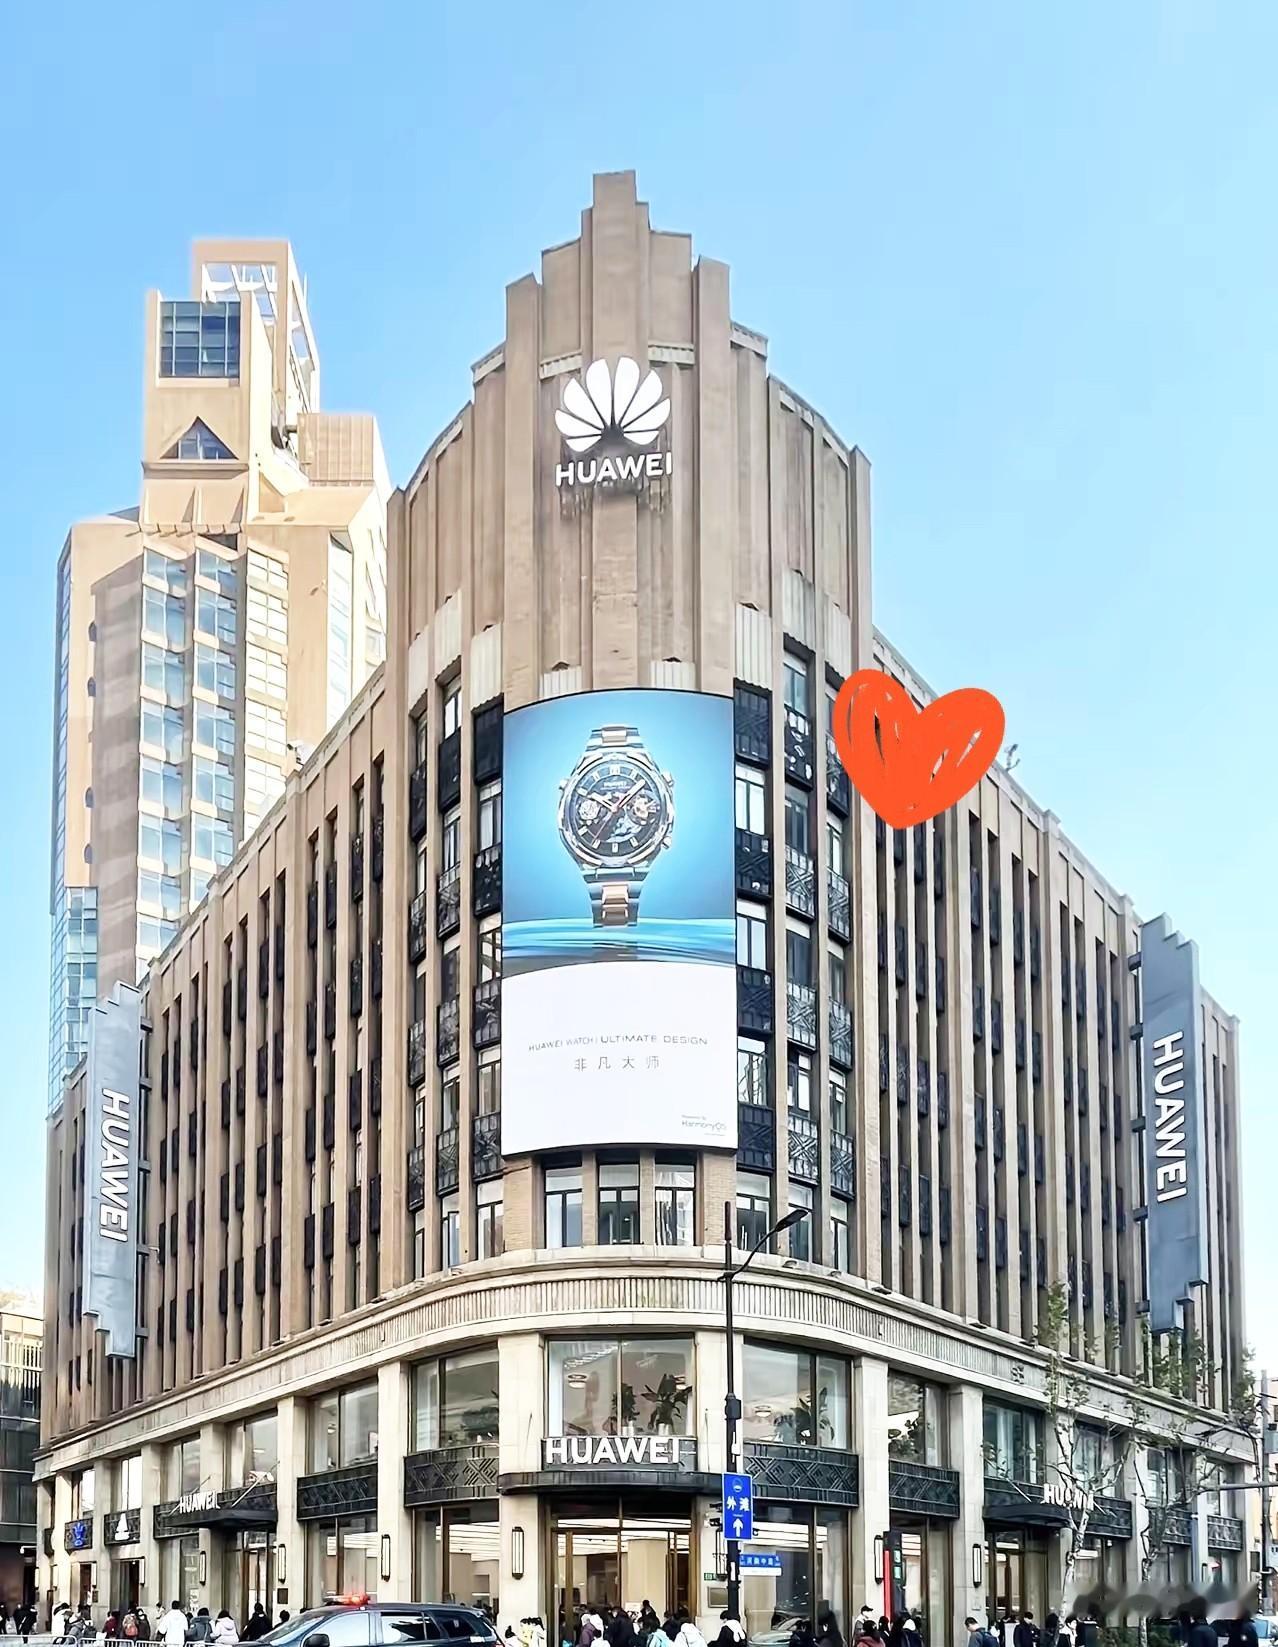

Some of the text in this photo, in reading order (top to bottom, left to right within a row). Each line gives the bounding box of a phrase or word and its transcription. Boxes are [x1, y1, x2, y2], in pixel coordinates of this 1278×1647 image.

[555, 452, 672, 486] HUAWEI
[528, 1035, 708, 1051] HUAWEI WATCH ULTIMATE DESIGN
[574, 1055, 660, 1071] 非凡大师
[1153, 1031, 1188, 1202] HUAWEI
[100, 1088, 130, 1242] HUAWEI
[546, 1437, 680, 1464] HUAWEI
[180, 1490, 218, 1514] HUAWEI
